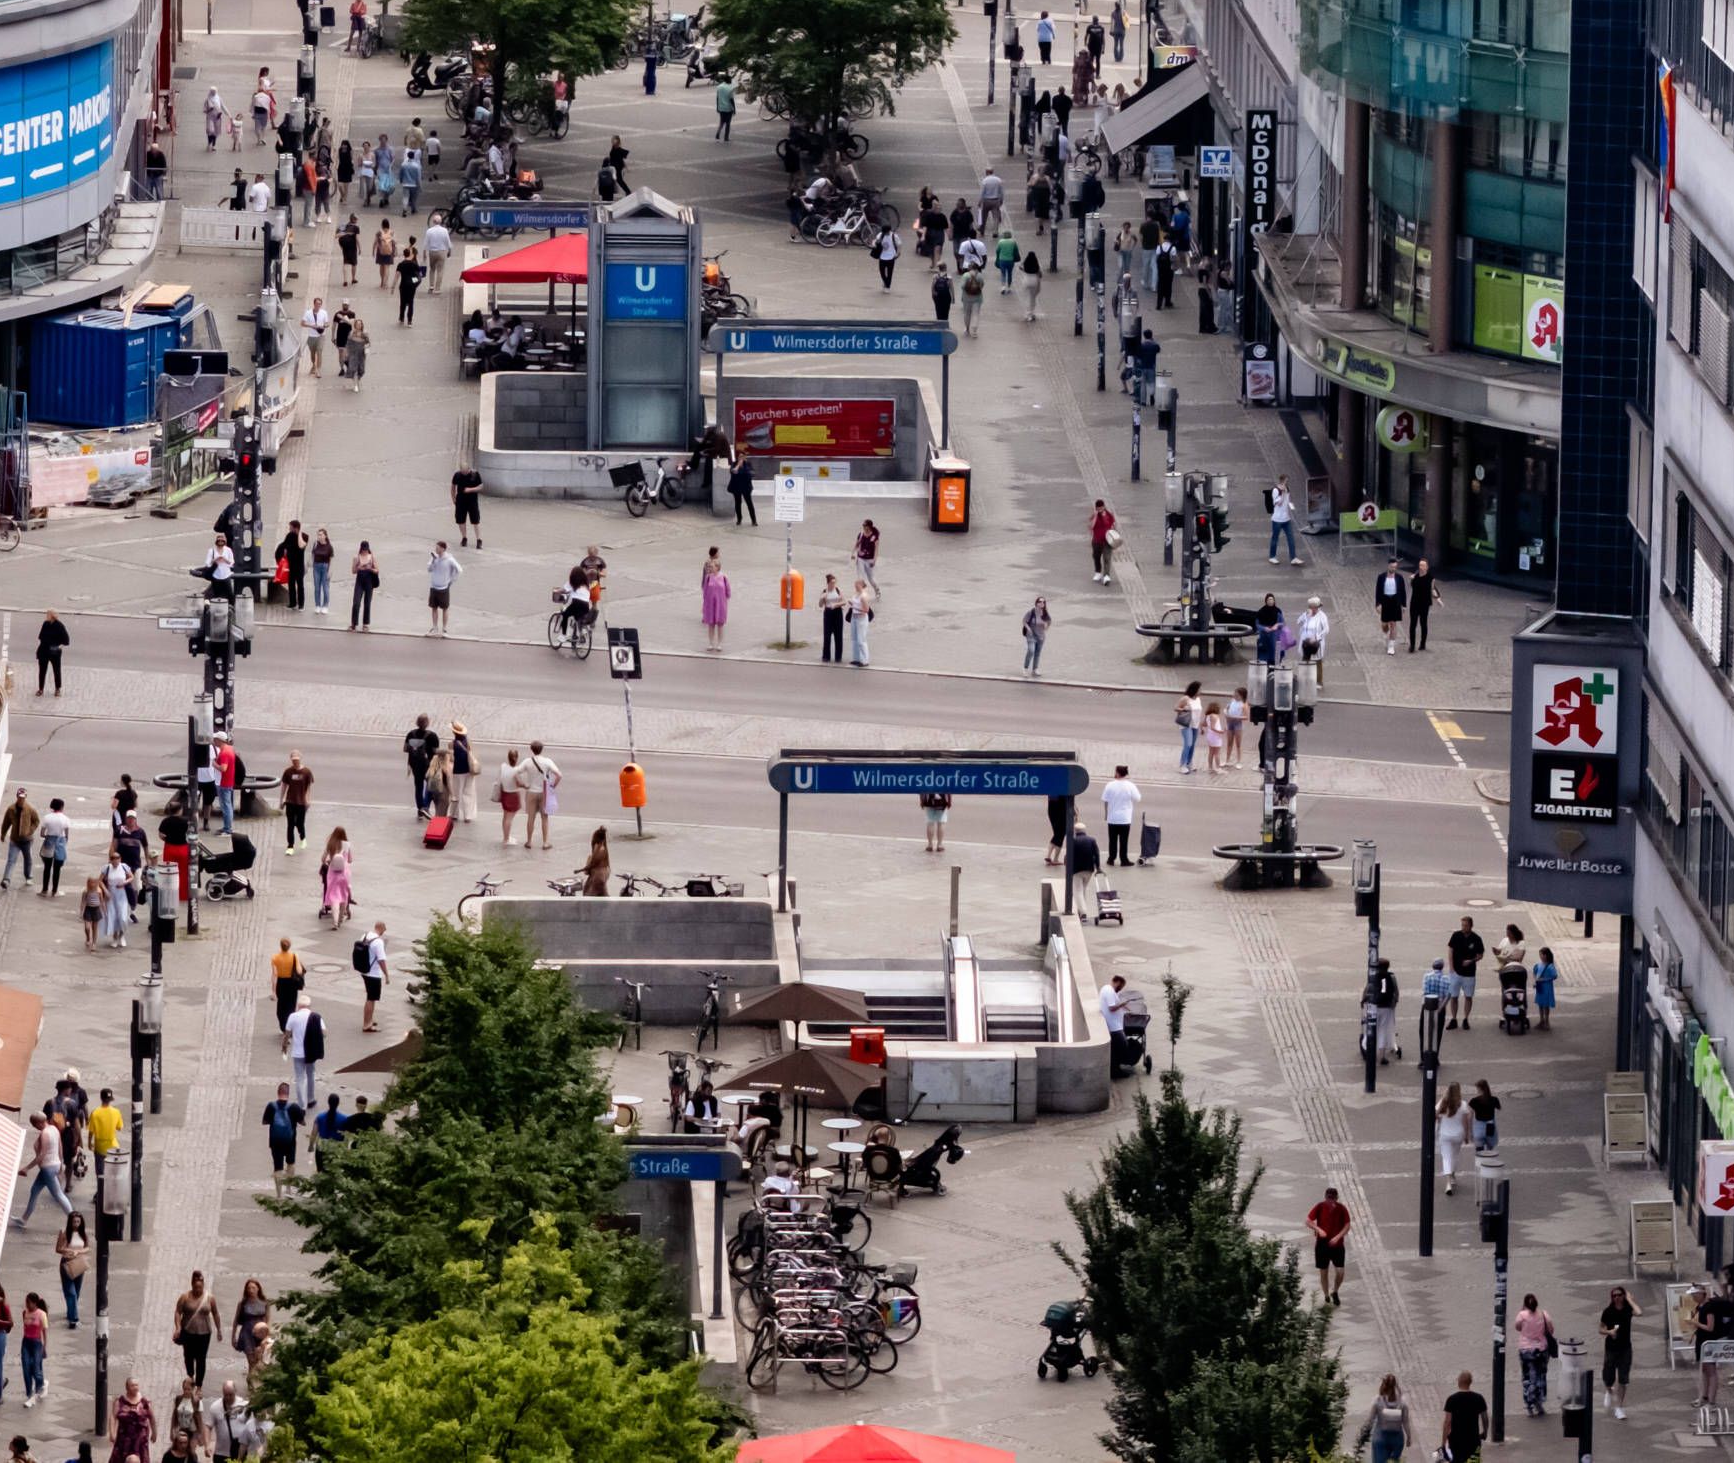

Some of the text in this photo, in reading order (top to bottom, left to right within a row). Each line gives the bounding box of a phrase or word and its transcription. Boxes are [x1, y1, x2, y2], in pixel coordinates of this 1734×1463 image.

[69, 84, 111, 138] PARKING
[1202, 166, 1230, 175] Bank
[480, 212, 491, 224] U
[513, 212, 582, 225] Wilmersdorfer
[635, 266, 656, 292] U
[617, 296, 674, 306] Wilmersdorfer
[730, 332, 918, 350] U Wilmersdorfer Straße
[791, 402, 843, 419] sprechen!
[794, 766, 1040, 789] U Wilmersdorfer Straße
[1549, 768, 1576, 800] E
[1534, 803, 1612, 818] ZIGARETTEN
[640, 1157, 691, 1175] Straße
